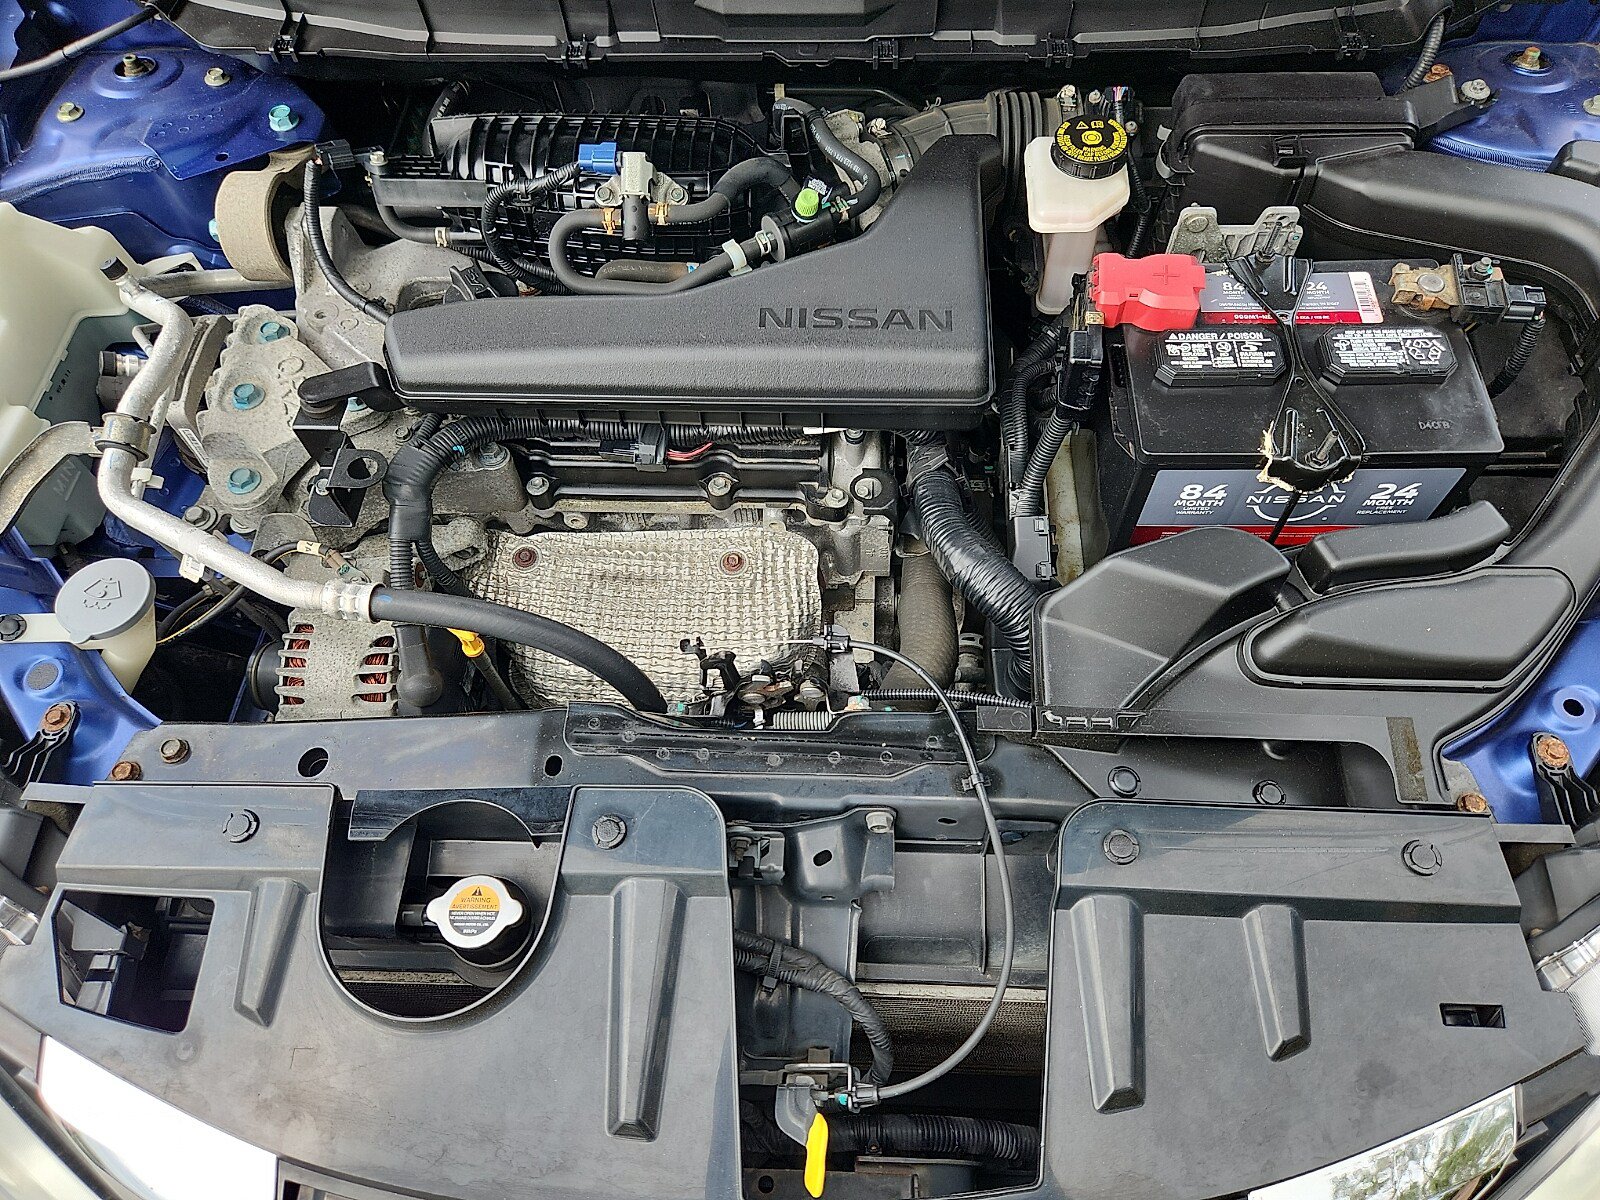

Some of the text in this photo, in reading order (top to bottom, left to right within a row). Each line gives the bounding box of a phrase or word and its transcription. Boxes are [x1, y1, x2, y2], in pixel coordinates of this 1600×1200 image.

[1222, 282, 1245, 291] 84
[1306, 281, 1327, 291] 24
[758, 307, 953, 331] NISSAN
[1227, 332, 1264, 340] POISON
[1180, 484, 1229, 500] 84
[1370, 482, 1423, 500] 24
[1246, 494, 1346, 504] NISSAN
